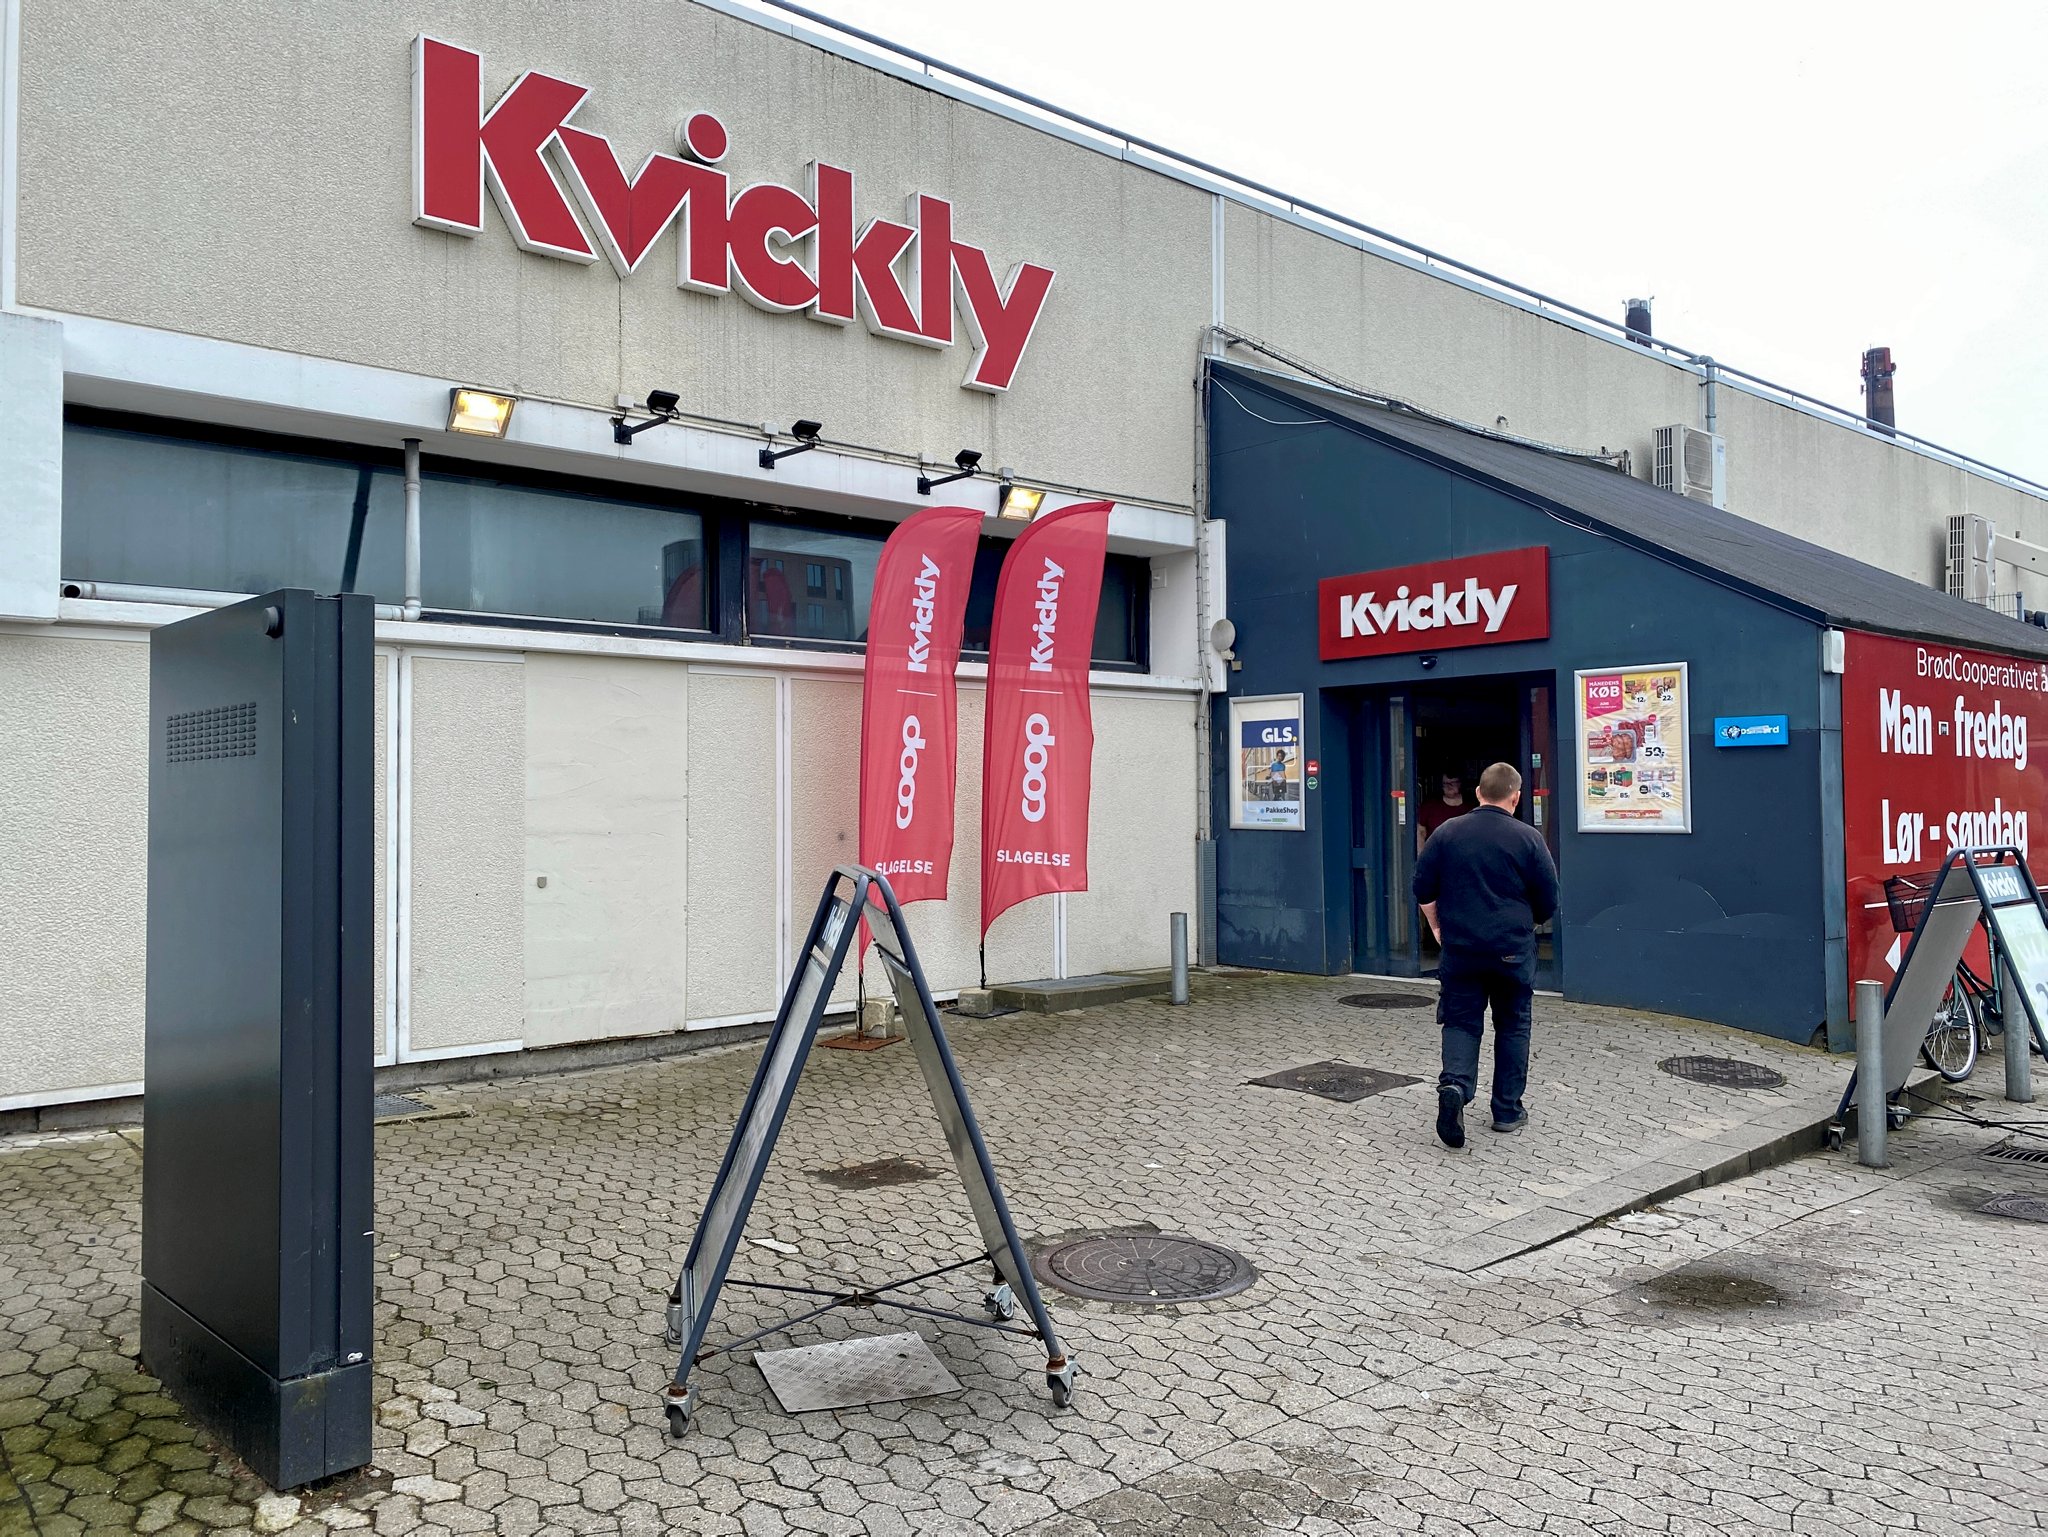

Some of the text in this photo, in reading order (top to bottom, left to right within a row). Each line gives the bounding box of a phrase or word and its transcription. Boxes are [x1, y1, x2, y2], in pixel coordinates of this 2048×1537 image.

[412, 33, 1056, 393] Kvickly
[907, 553, 941, 672] Kvickly
[1029, 557, 1065, 672] Kvickly
[1340, 577, 1518, 638] Kvickly
[1589, 686, 1620, 698] KØB
[1917, 647, 2039, 691] BrødCooperativet
[1880, 688, 1933, 755] Man
[1954, 695, 2028, 771] fredag
[896, 715, 926, 829] coop
[1022, 713, 1055, 822] coop
[1265, 807, 1299, 815] PakkeShop
[1882, 799, 1924, 864] Lør
[1945, 797, 2029, 865] søndag
[875, 859, 933, 875] SLAGELSE
[997, 850, 1070, 866] SLAGELSE
